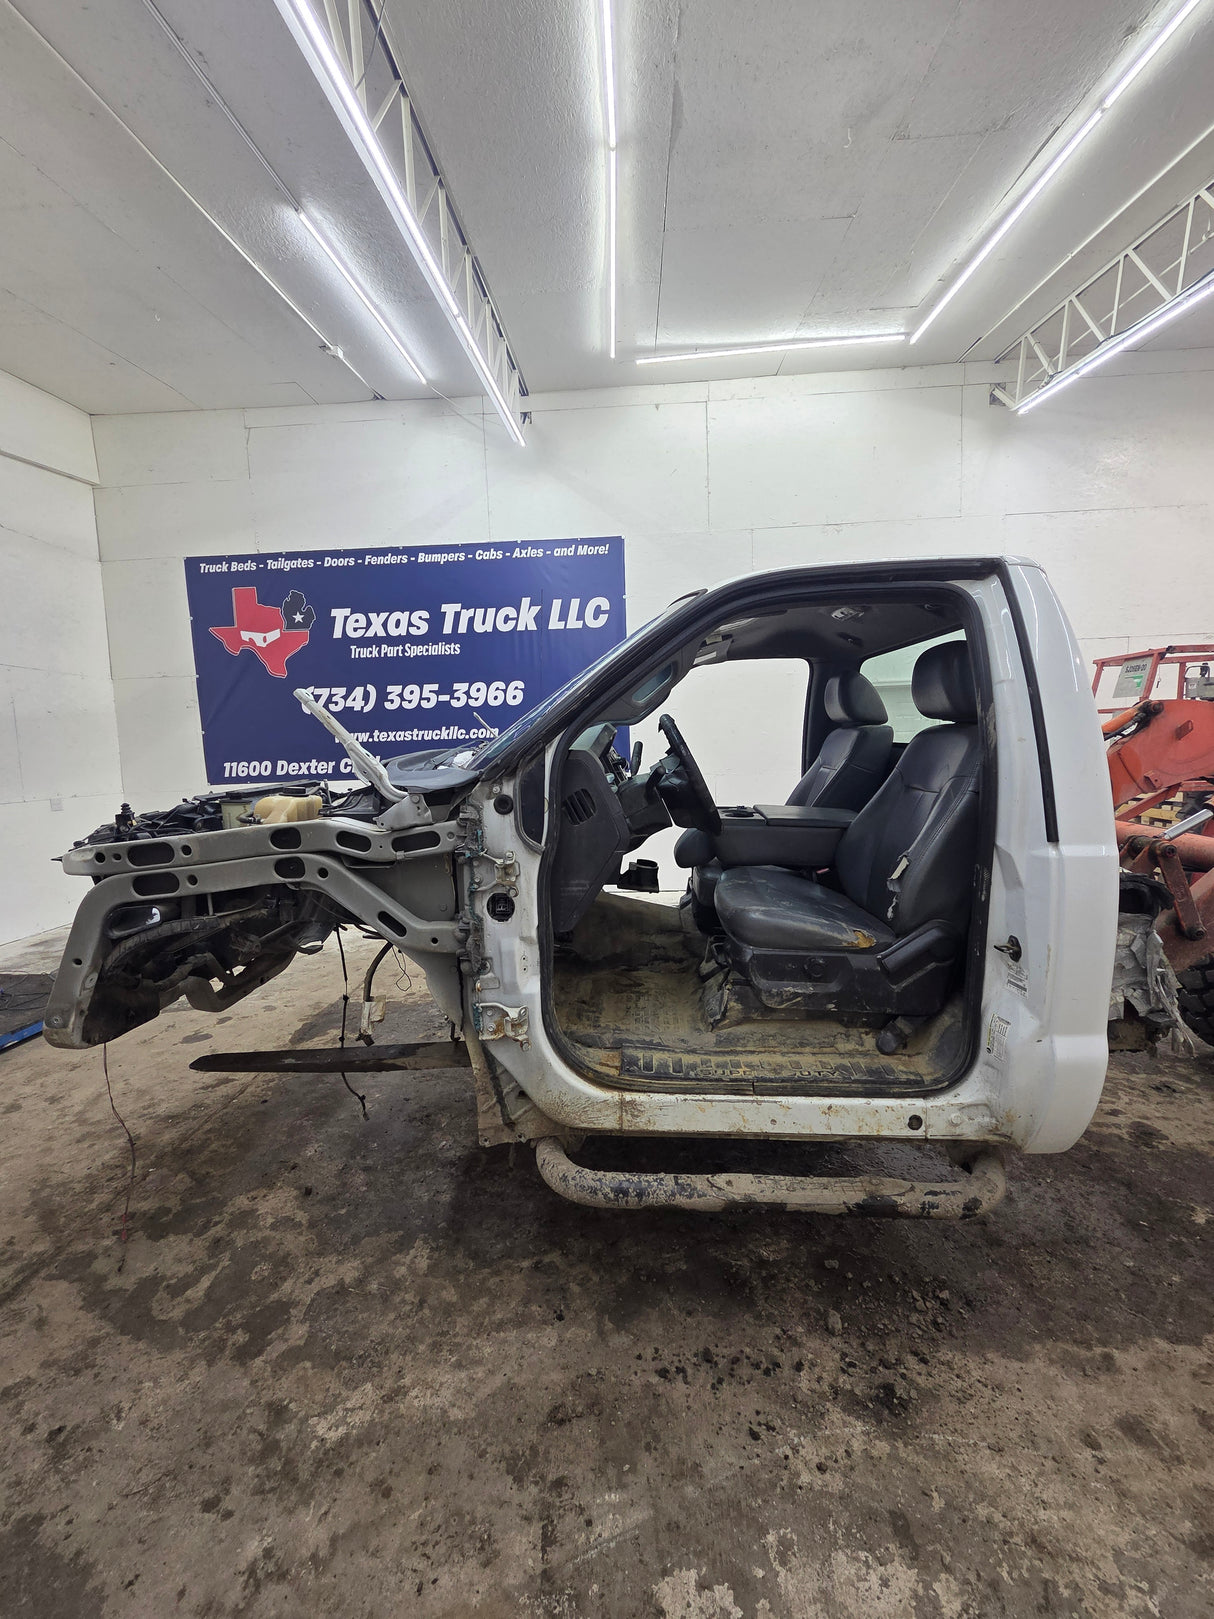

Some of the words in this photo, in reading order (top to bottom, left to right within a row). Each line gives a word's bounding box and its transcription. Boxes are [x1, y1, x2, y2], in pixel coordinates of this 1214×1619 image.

[199, 562, 229, 573] Truck
[230, 560, 257, 571] Beds
[266, 557, 314, 571] Tailgates
[324, 556, 355, 567] Doors
[364, 553, 408, 565] Fenders
[417, 552, 465, 564] Bumpers
[475, 548, 503, 560] Cabs
[512, 546, 544, 558] Axles
[553, 545, 576, 556] and
[577, 543, 609, 555] More!
[330, 607, 430, 639] Texas
[440, 597, 542, 635] Truck
[547, 596, 610, 630] LLC
[350, 645, 379, 658] Truck
[381, 644, 403, 657] Part
[404, 641, 461, 658] Specialists
[383, 680, 525, 710] 395-3966
[334, 725, 499, 743] w.texastruckllc.com
[223, 761, 272, 778] 11600
[276, 758, 336, 776] Dexter
